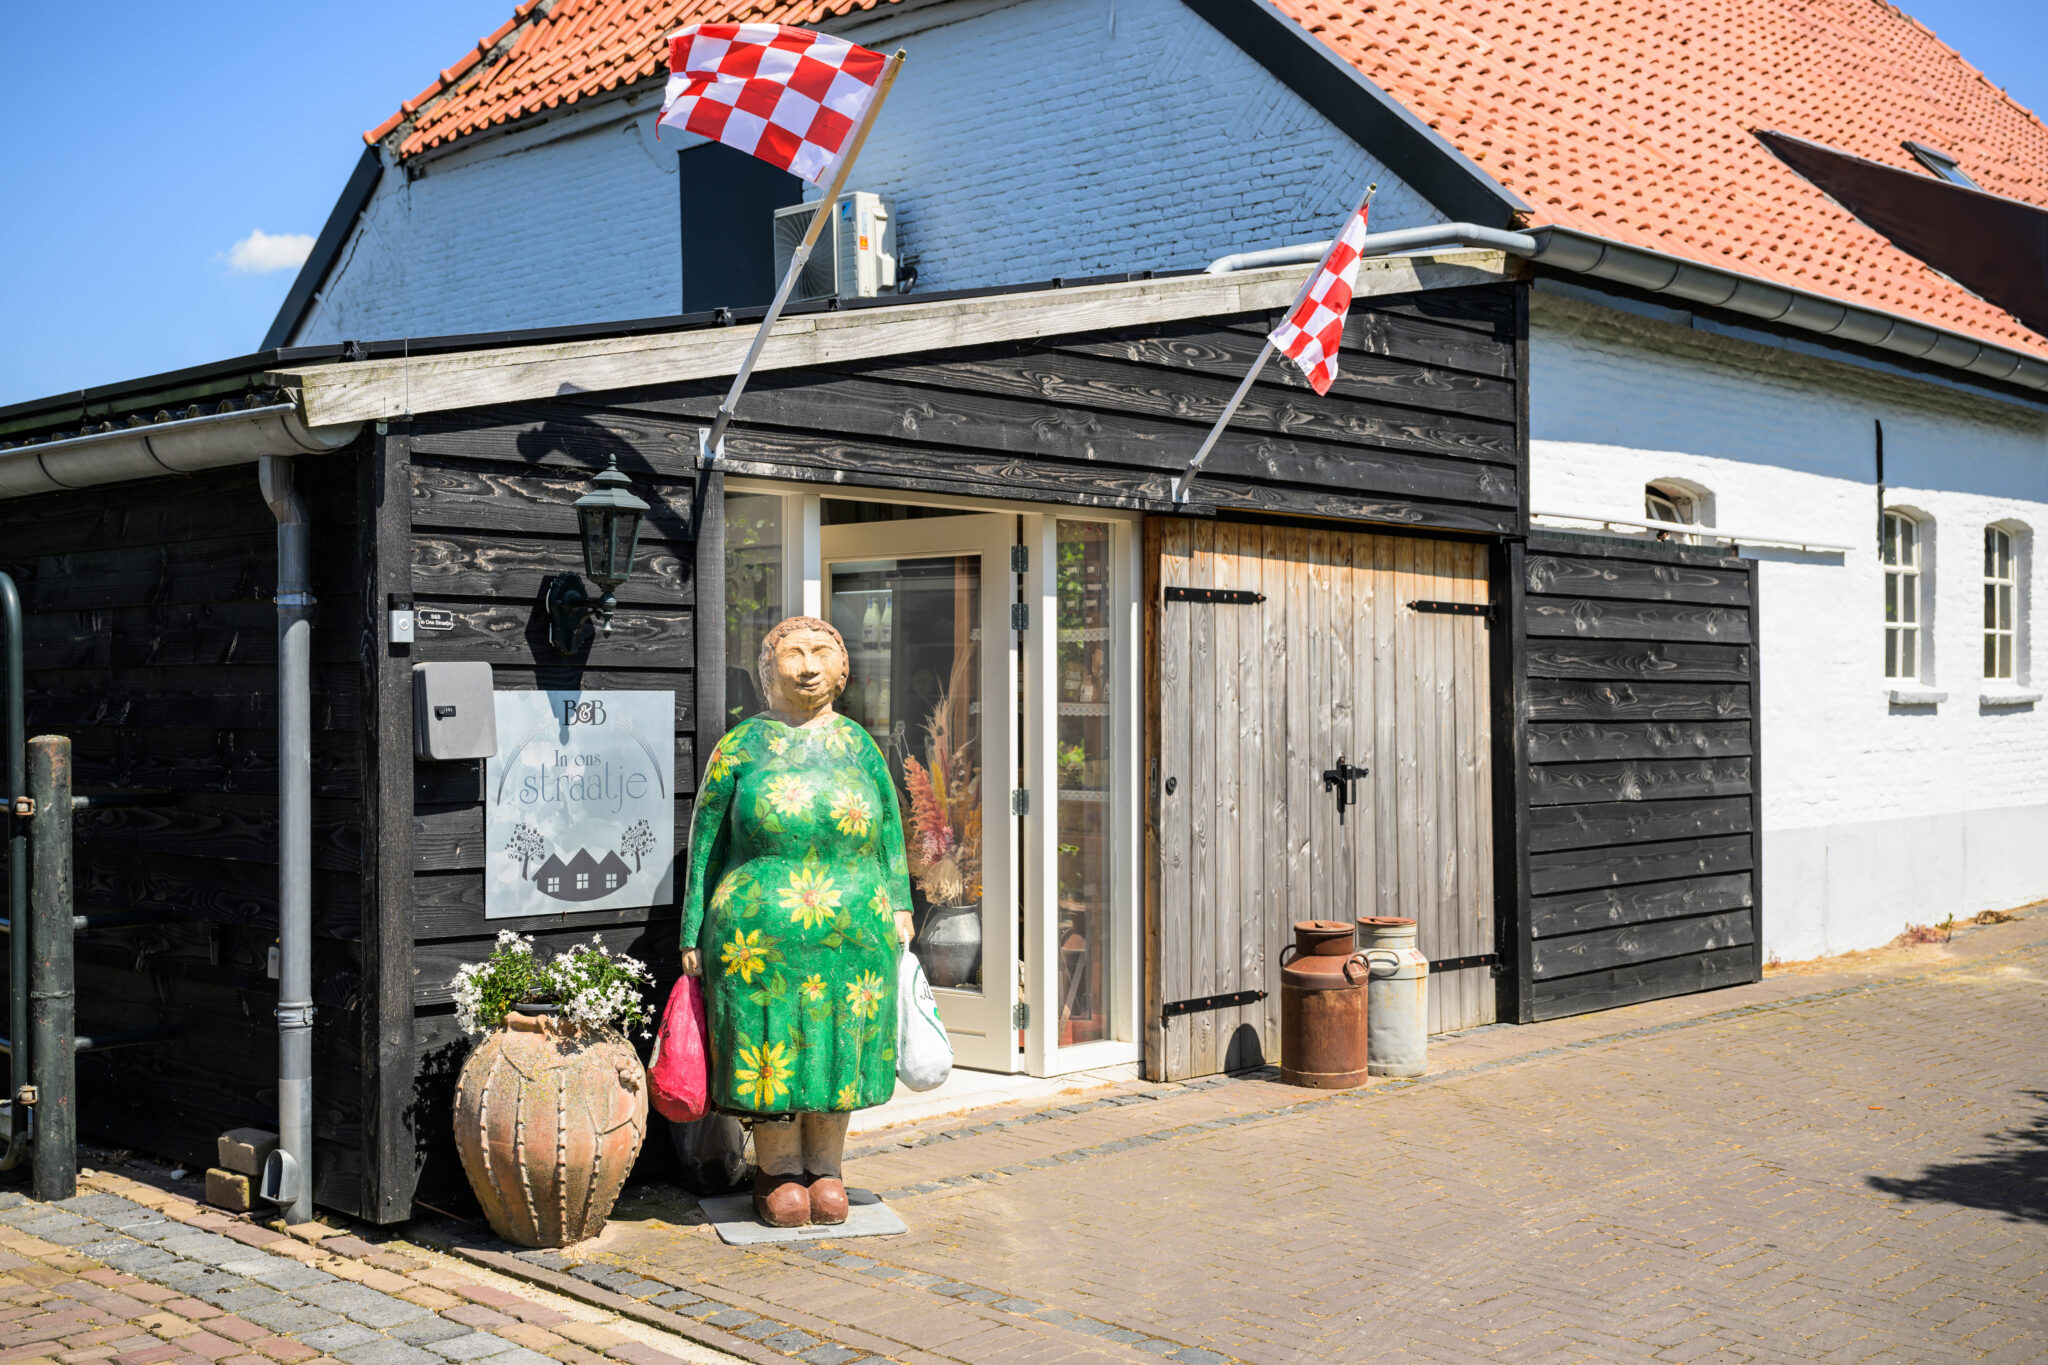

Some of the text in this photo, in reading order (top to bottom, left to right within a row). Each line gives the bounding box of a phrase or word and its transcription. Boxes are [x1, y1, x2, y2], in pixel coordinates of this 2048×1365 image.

[563, 699, 607, 726] B&B
[554, 749, 601, 767] In ons
[519, 761, 648, 814] straatje
